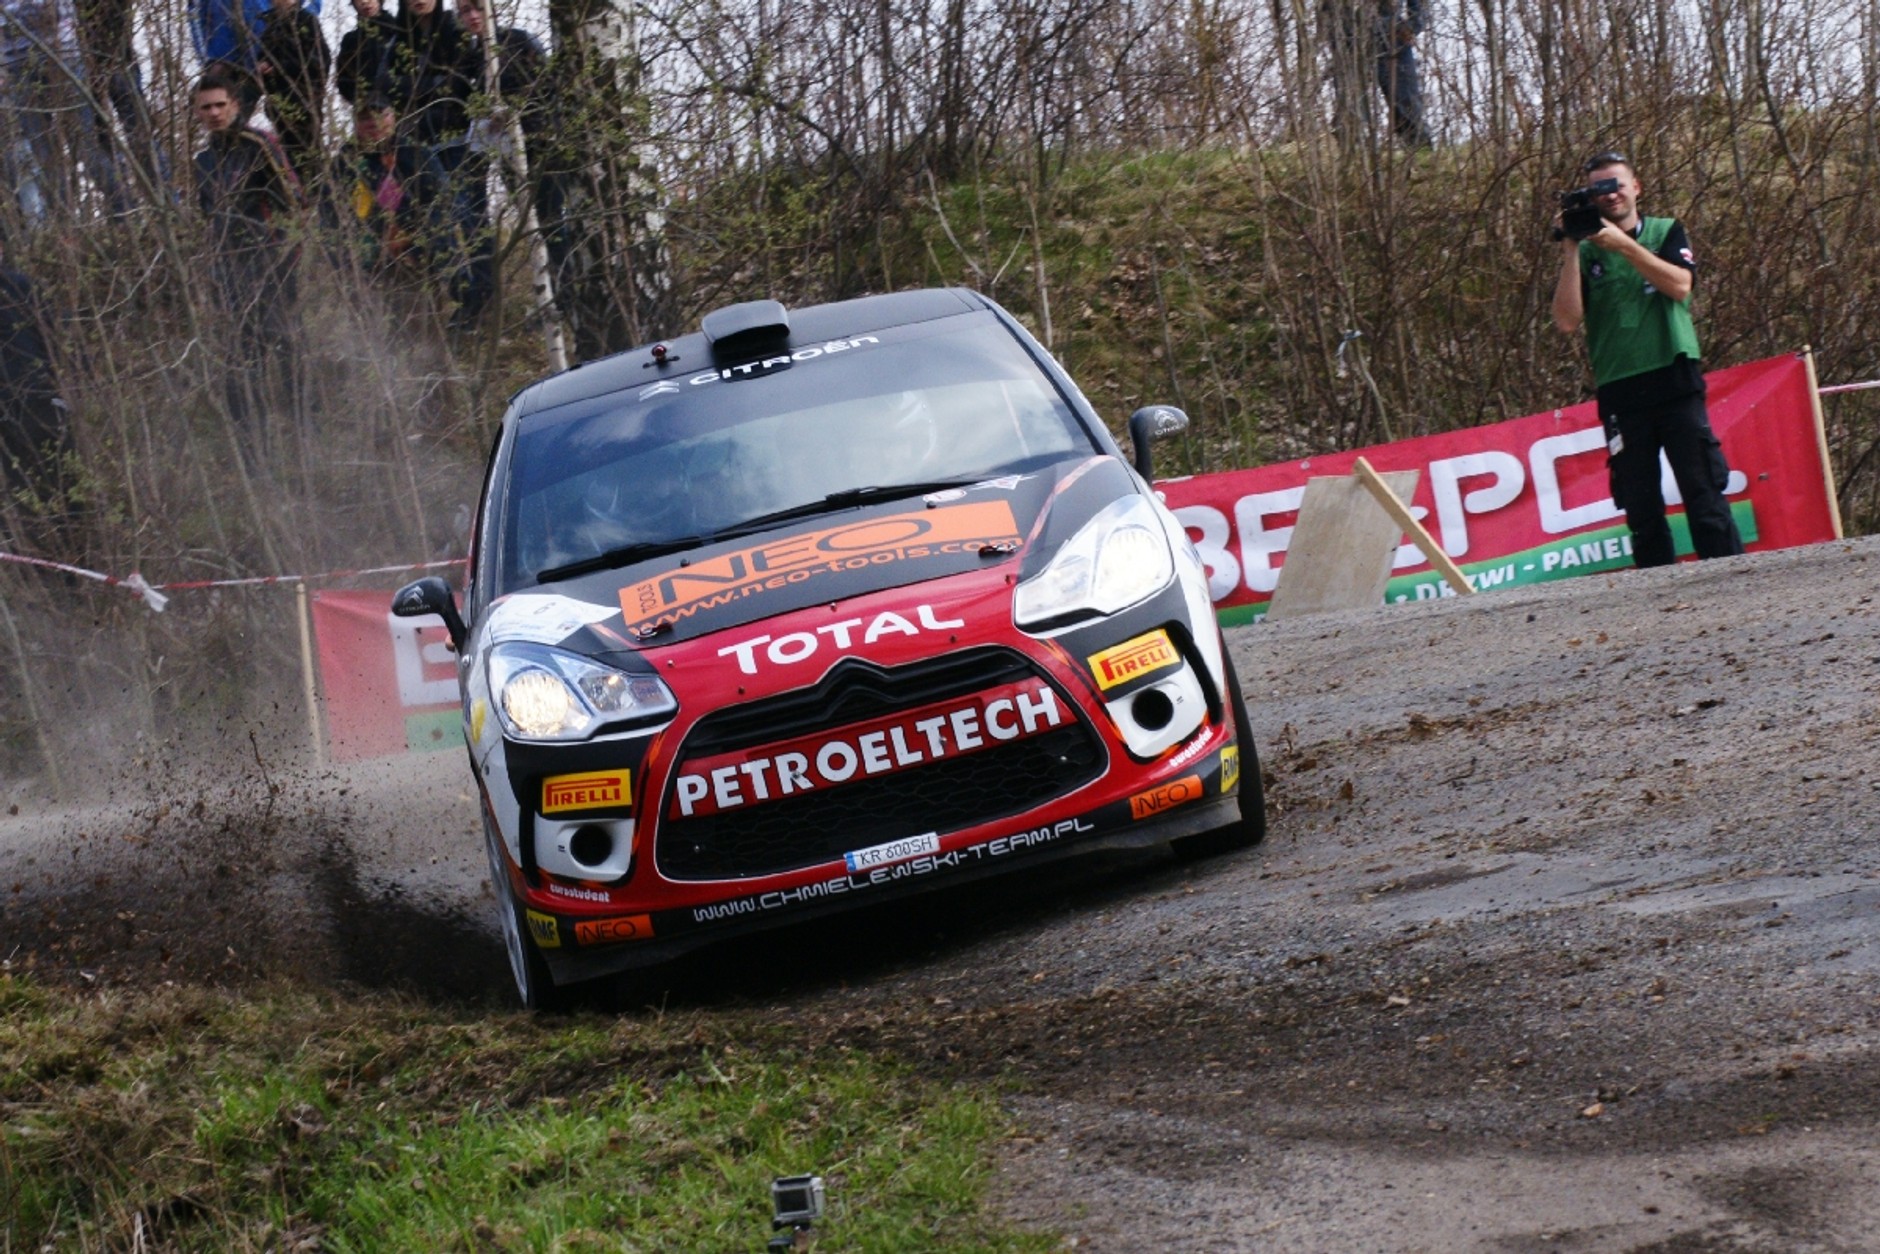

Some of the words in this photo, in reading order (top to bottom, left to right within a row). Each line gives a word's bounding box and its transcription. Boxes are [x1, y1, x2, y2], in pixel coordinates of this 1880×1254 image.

[658, 518, 932, 606] NEO
[717, 604, 965, 675] TOTAL
[1099, 636, 1172, 682] PIRELLI
[676, 686, 1061, 816] PETROELTECH
[545, 777, 622, 807] PIRELLI
[1138, 783, 1189, 815] NEO
[693, 818, 1095, 922] WWW.CHMIELEWSKI-TEAM.PL
[859, 848, 883, 865] KR
[582, 920, 638, 943] NEO
